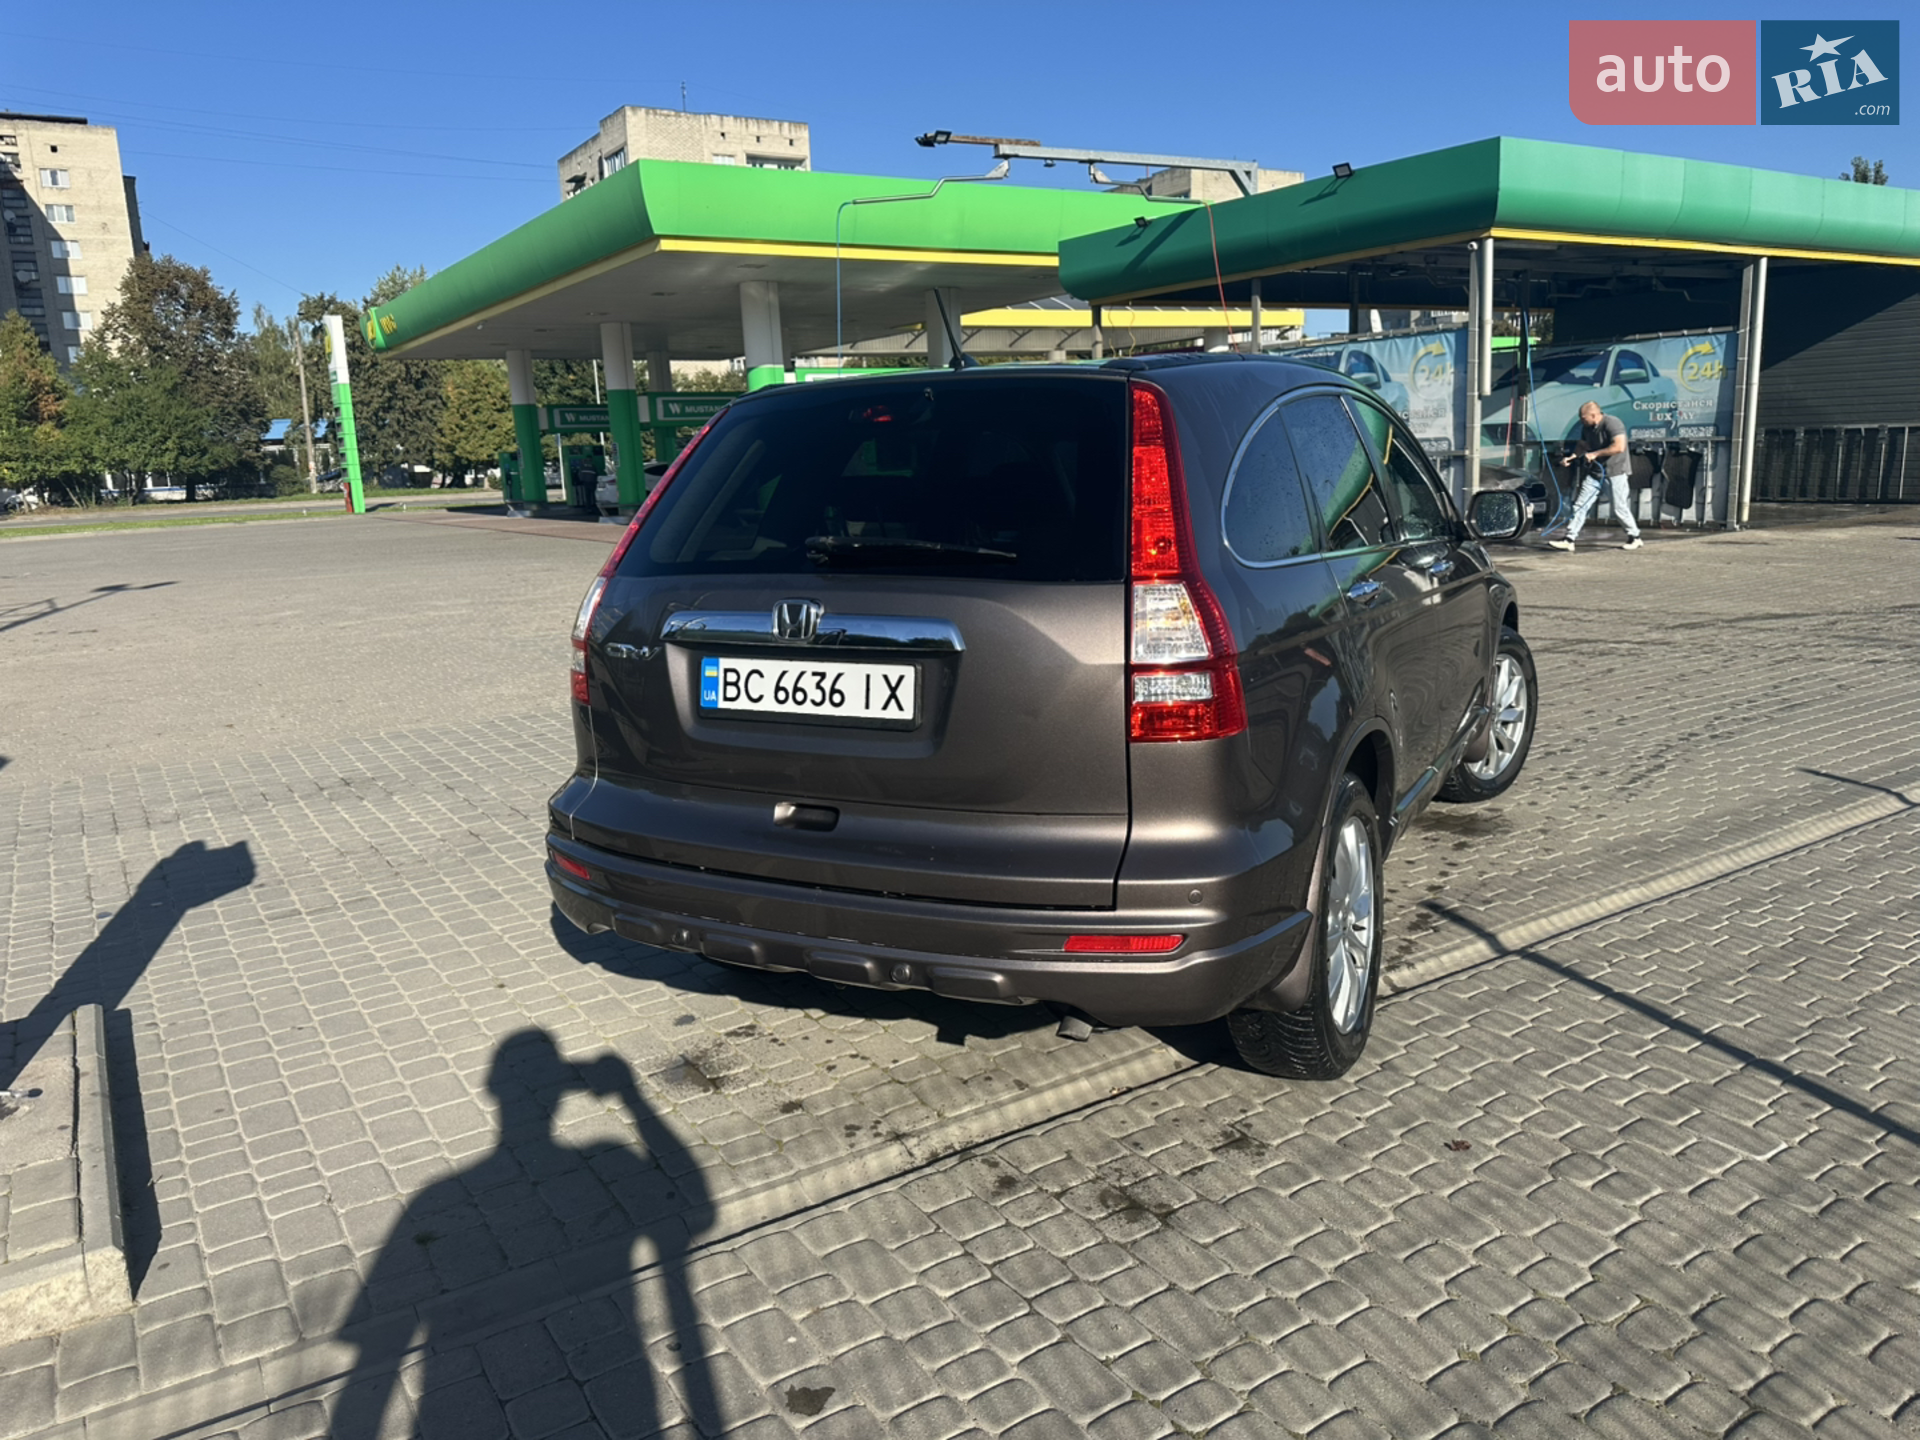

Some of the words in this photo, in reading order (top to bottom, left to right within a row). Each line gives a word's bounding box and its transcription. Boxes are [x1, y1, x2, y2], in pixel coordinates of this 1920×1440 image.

[1687, 359, 1727, 381] 24h
[684, 404, 722, 414] MUSTAN
[579, 414, 610, 422] MUSTAN
[722, 667, 765, 703] BC
[773, 670, 846, 708] 6636
[703, 690, 717, 701] UA
